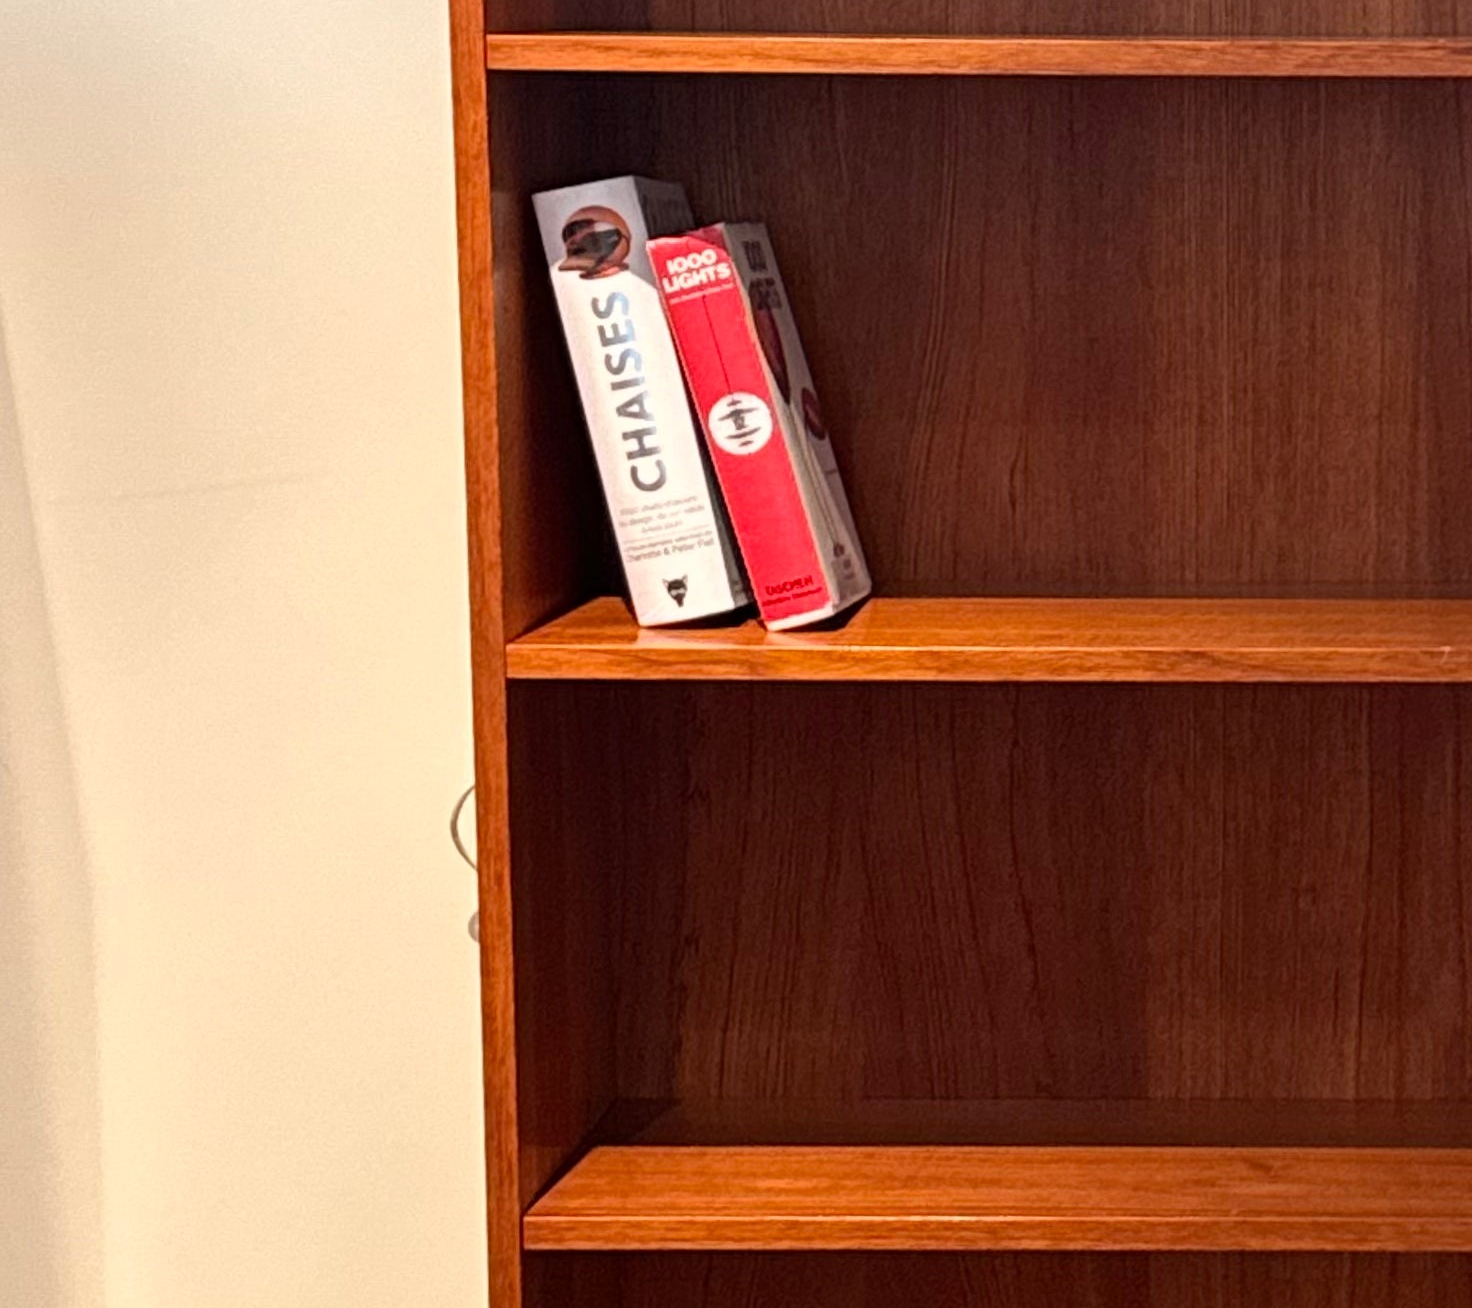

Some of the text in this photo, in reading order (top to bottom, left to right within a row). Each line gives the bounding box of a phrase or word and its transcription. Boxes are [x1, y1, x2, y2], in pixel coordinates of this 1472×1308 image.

[666, 248, 718, 275] 1000
[662, 262, 732, 294] LIGHTS
[591, 291, 667, 492] CHAISES
